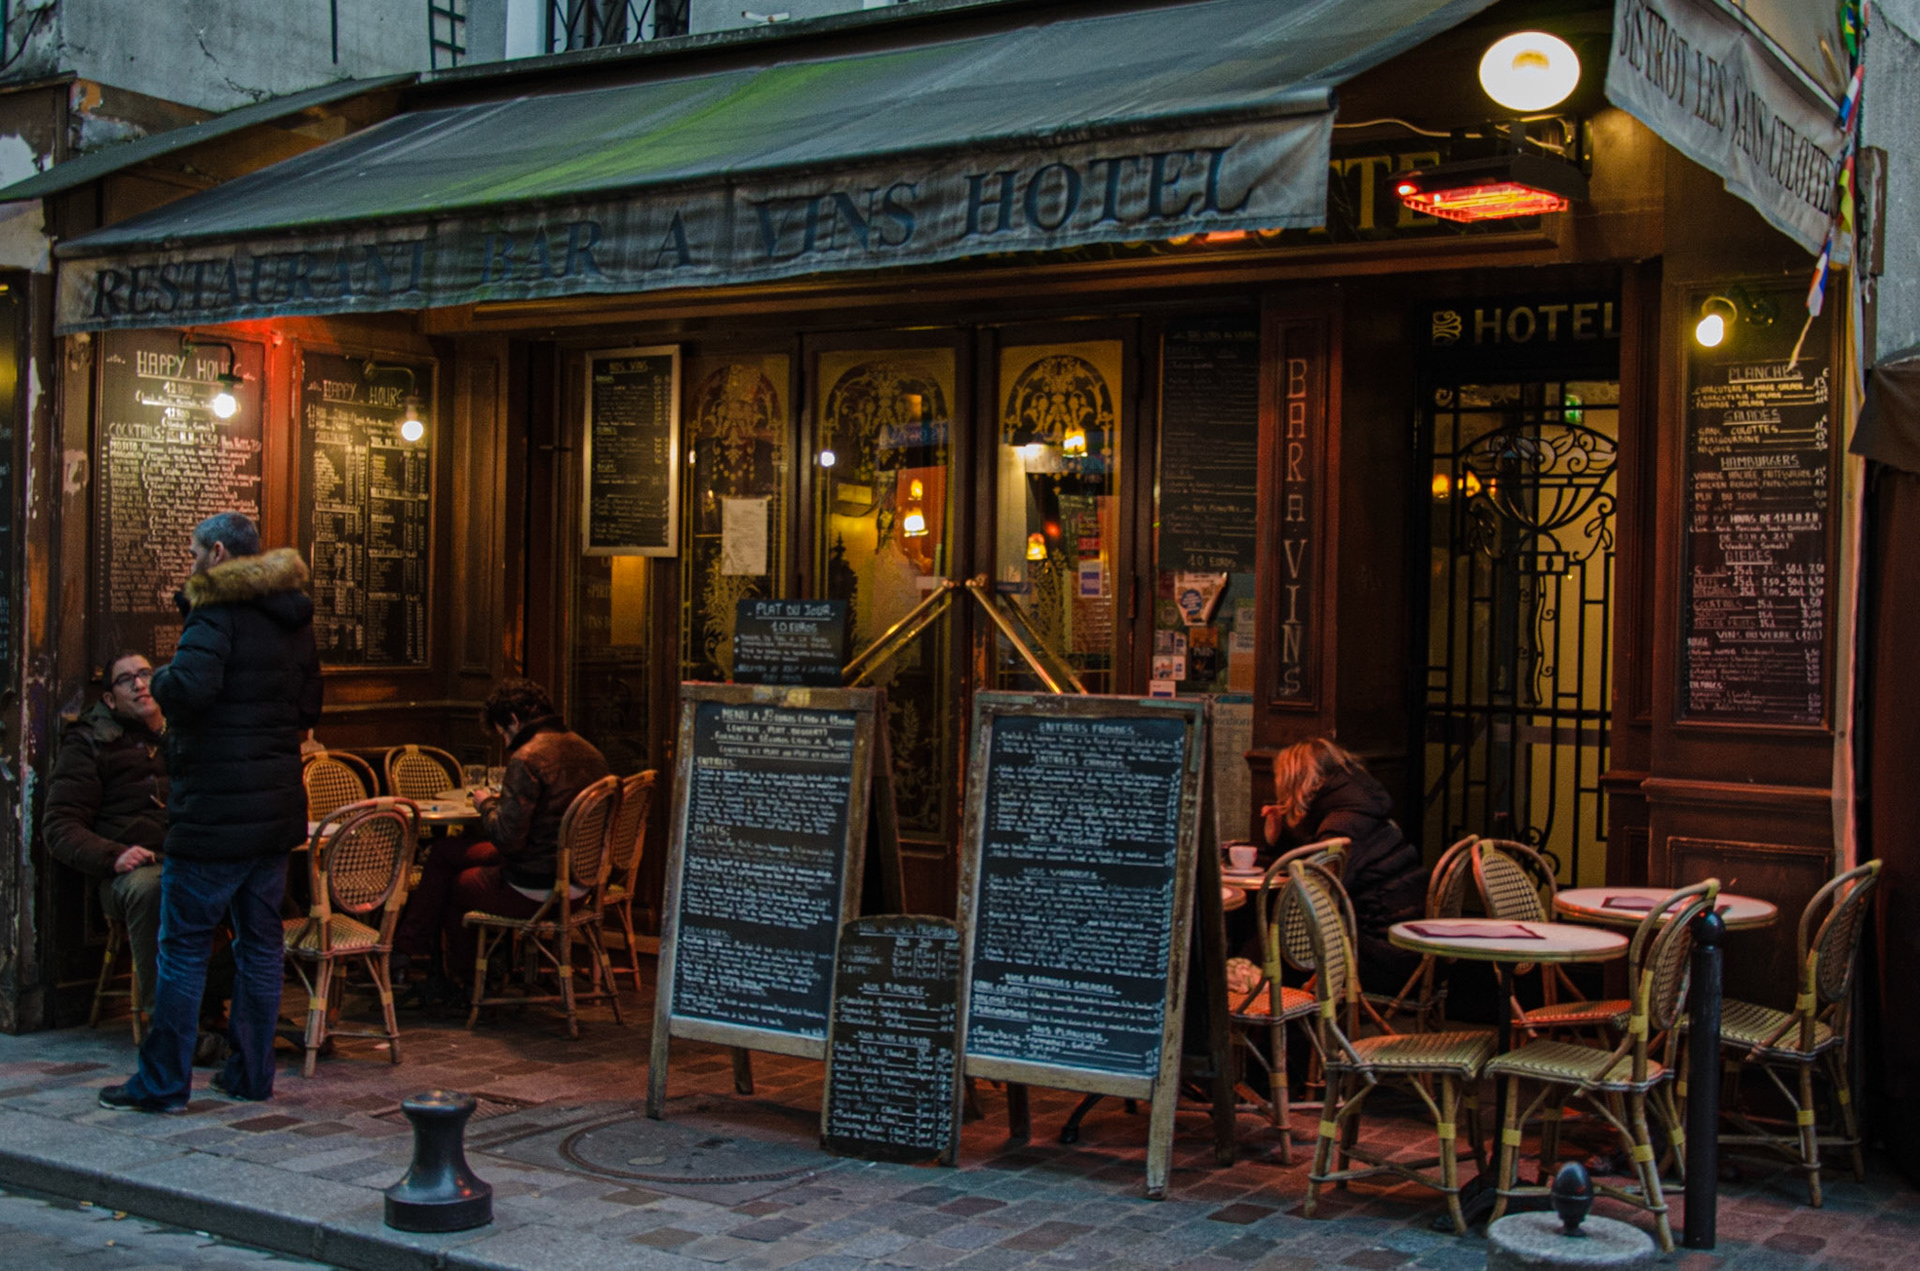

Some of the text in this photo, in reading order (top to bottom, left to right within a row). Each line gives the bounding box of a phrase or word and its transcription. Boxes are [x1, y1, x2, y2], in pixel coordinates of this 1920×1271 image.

[90, 237, 438, 319] RESTAURANT
[480, 220, 602, 284] BAR
[653, 209, 702, 269] A
[750, 181, 918, 258] VINS
[963, 145, 1260, 240] HOTEL
[1474, 303, 1620, 345] HOTEL
[137, 350, 186, 377] HAPPY
[1729, 364, 1802, 380] PLANCHES
[323, 379, 358, 400] HAPPY
[1723, 408, 1780, 422] SALADES
[1720, 456, 1800, 468] HAMBURGERS
[1282, 359, 1309, 698] BAR A VINS
[755, 602, 831, 616] PLAT DU JOUR
